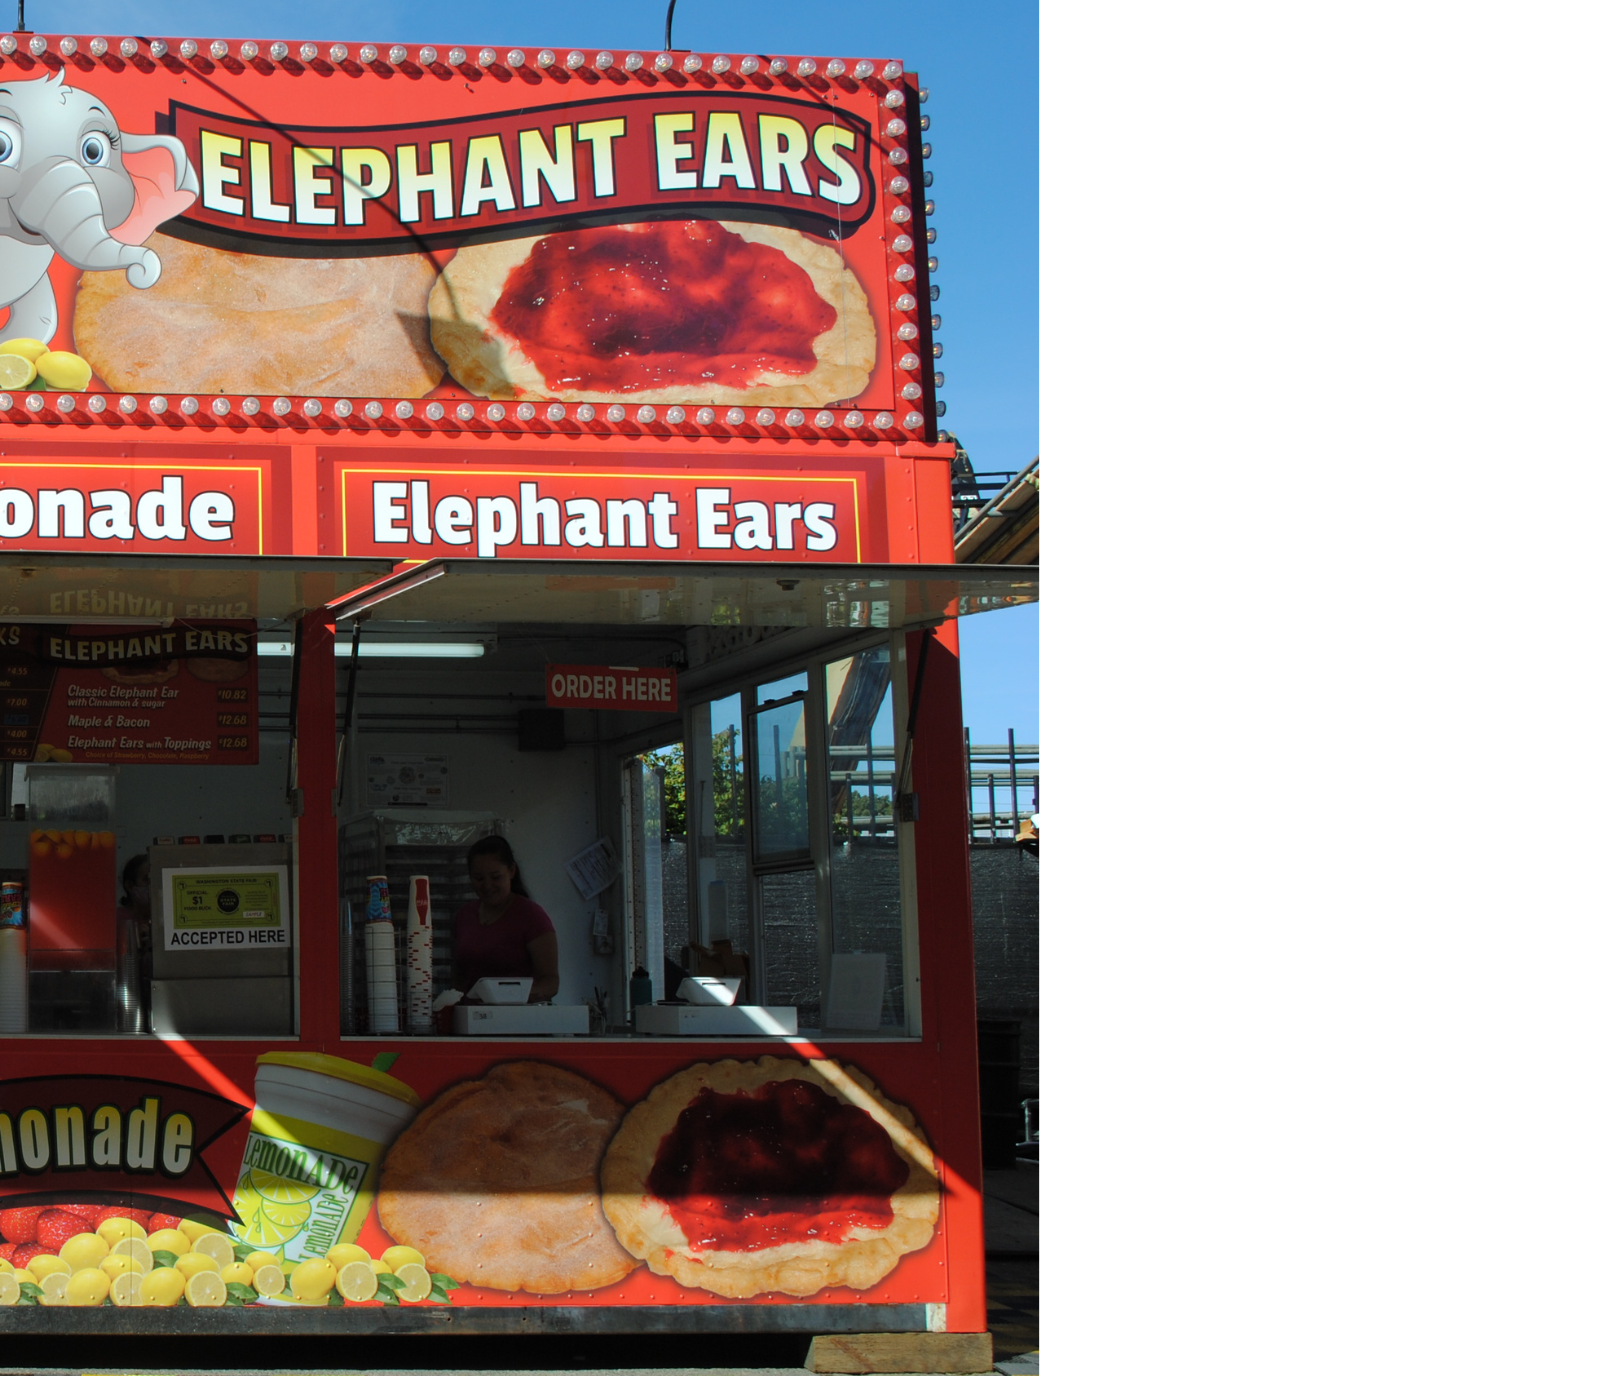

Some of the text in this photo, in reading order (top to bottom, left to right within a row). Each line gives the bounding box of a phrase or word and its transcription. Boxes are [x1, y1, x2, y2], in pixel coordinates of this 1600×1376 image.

[199, 110, 858, 227] ELEPHANT EARS
[372, 480, 838, 558] Elephant Ears
[50, 631, 248, 661] ELEPHANT EARS
[68, 685, 179, 700] Classic Elephant Ear
[551, 674, 672, 701] ORDER HERE
[218, 690, 246, 700] $10.82
[67, 698, 165, 709] with Cinnamon & sugar
[68, 715, 150, 728] Maple & Bacon
[219, 715, 247, 725] $12.68
[68, 736, 211, 751] Elephant Ears with Toppings
[219, 738, 248, 748] $12.68
[180, 752, 209, 760] Raspberry
[192, 896, 203, 905] $1
[171, 929, 285, 945] ACCEPTED HERE
